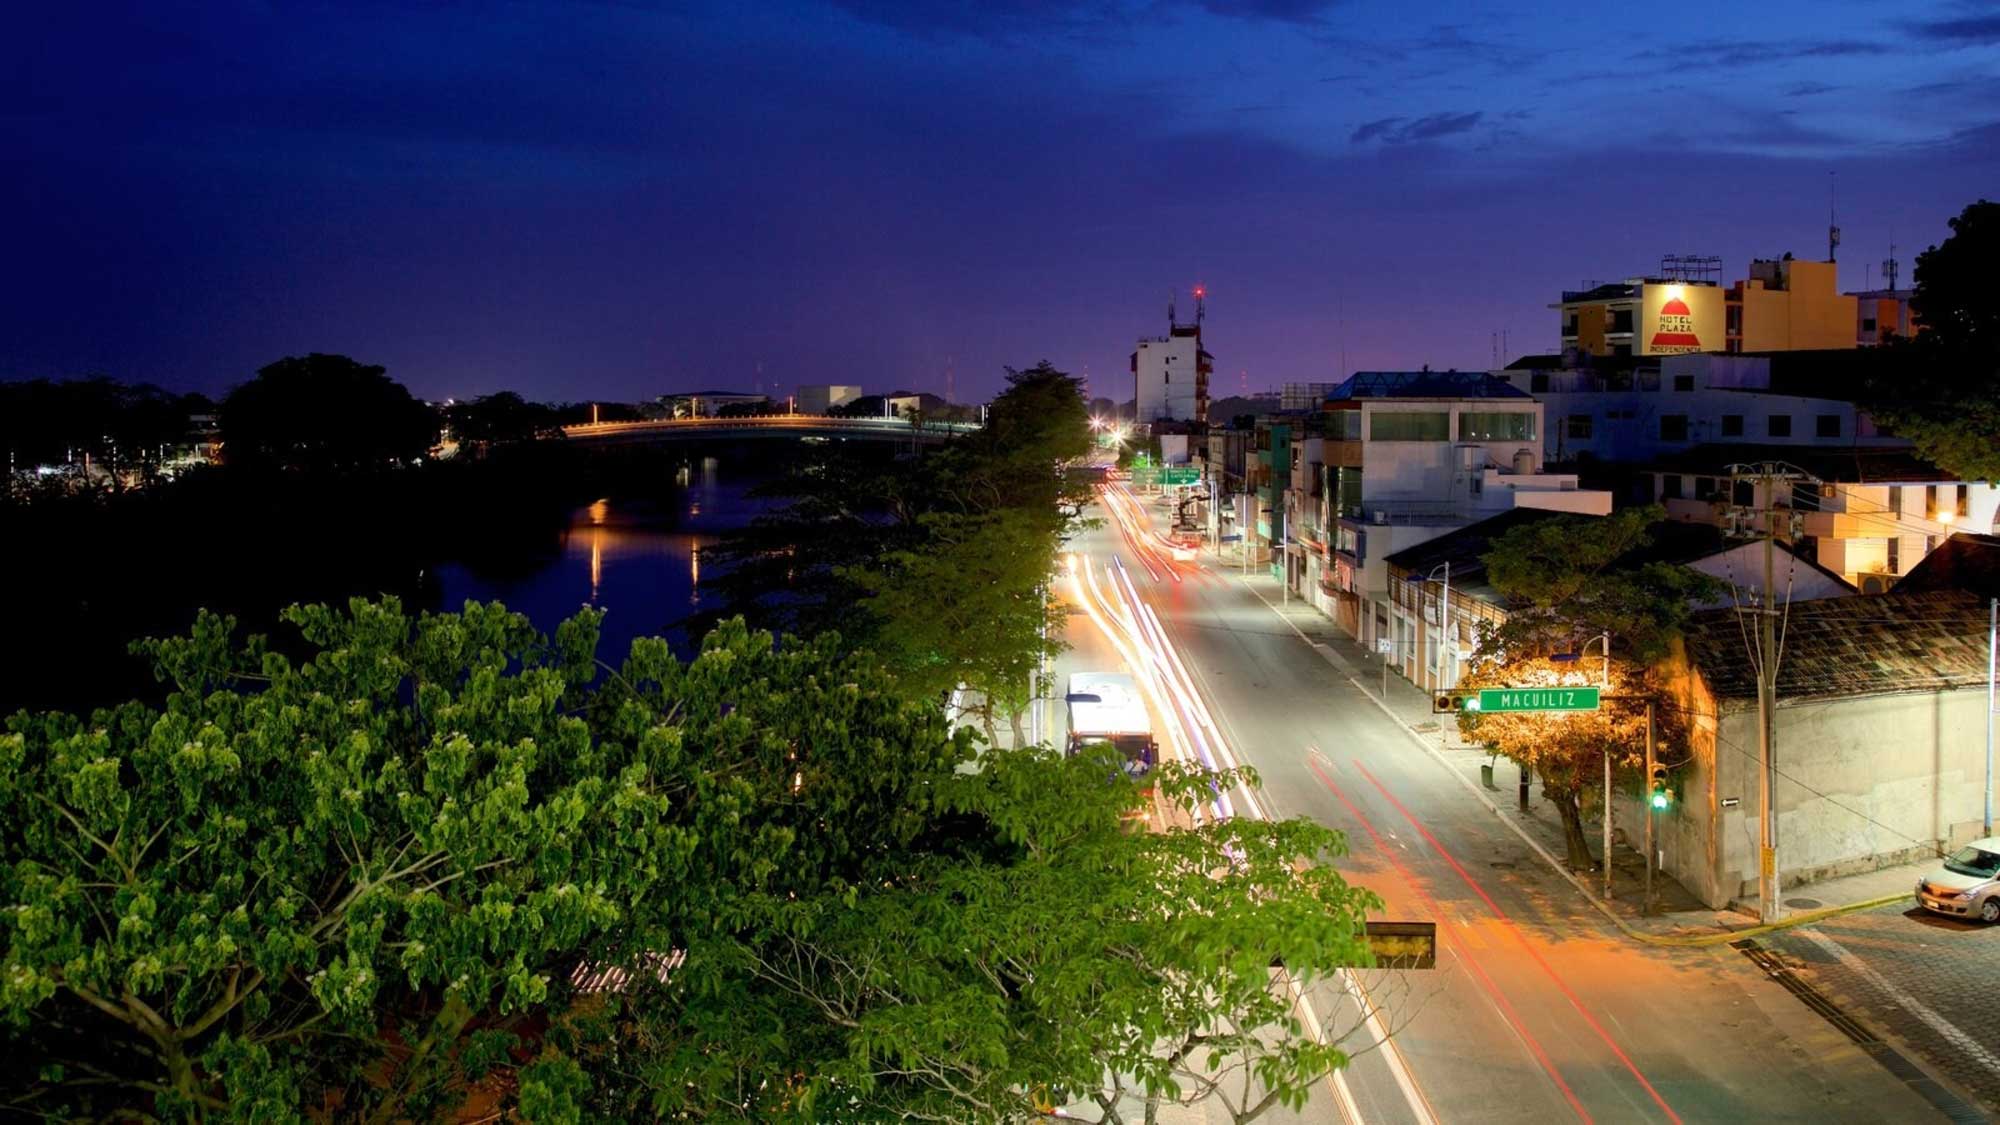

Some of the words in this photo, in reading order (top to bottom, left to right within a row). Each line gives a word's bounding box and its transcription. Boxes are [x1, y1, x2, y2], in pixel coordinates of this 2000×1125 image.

[1660, 316, 1692, 324] HOTEL
[1660, 324, 1692, 332] PLAZA
[1501, 692, 1575, 707] MACUILIZ
